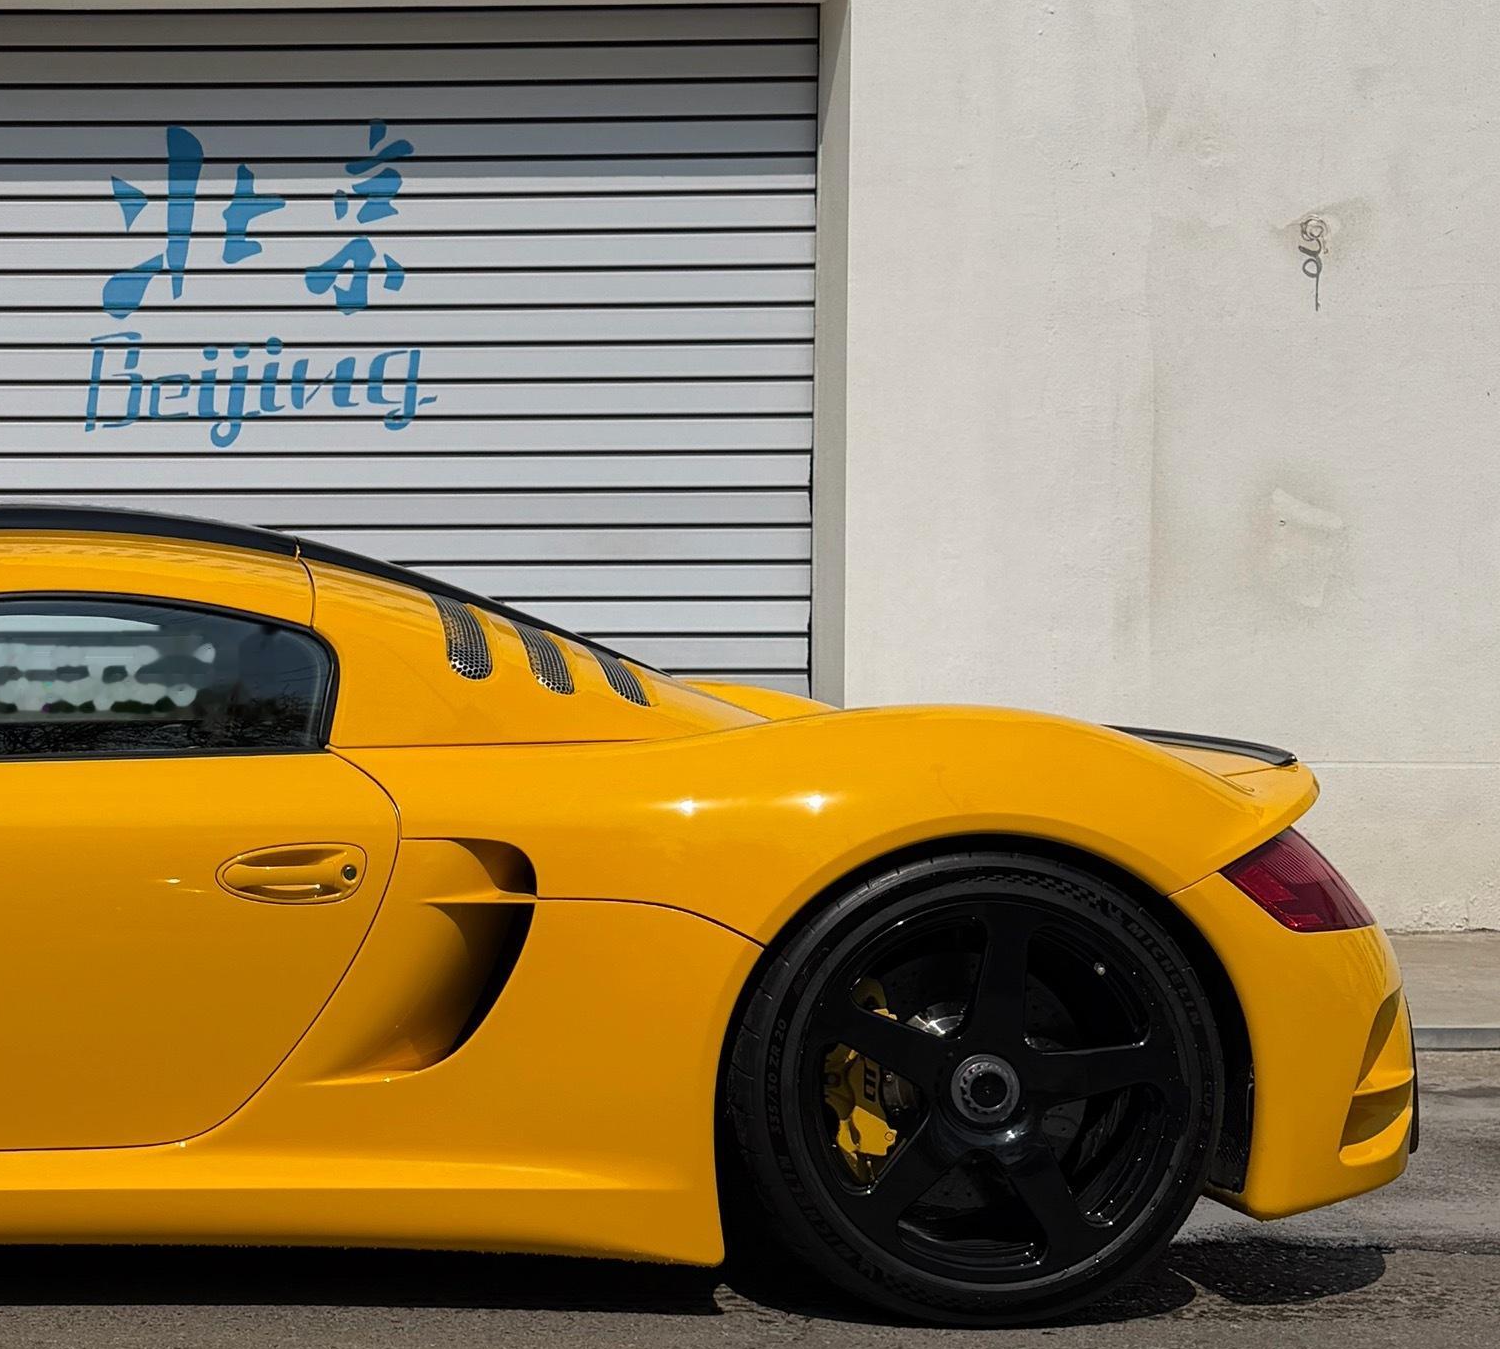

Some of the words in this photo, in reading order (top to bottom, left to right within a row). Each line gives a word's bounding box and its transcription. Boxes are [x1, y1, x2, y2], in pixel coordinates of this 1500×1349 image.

[101, 119, 414, 319] 北京
[84, 332, 437, 448] Beijing
[774, 1017, 788, 1042] 20
[1126, 921, 1202, 1027] MICHELIN
